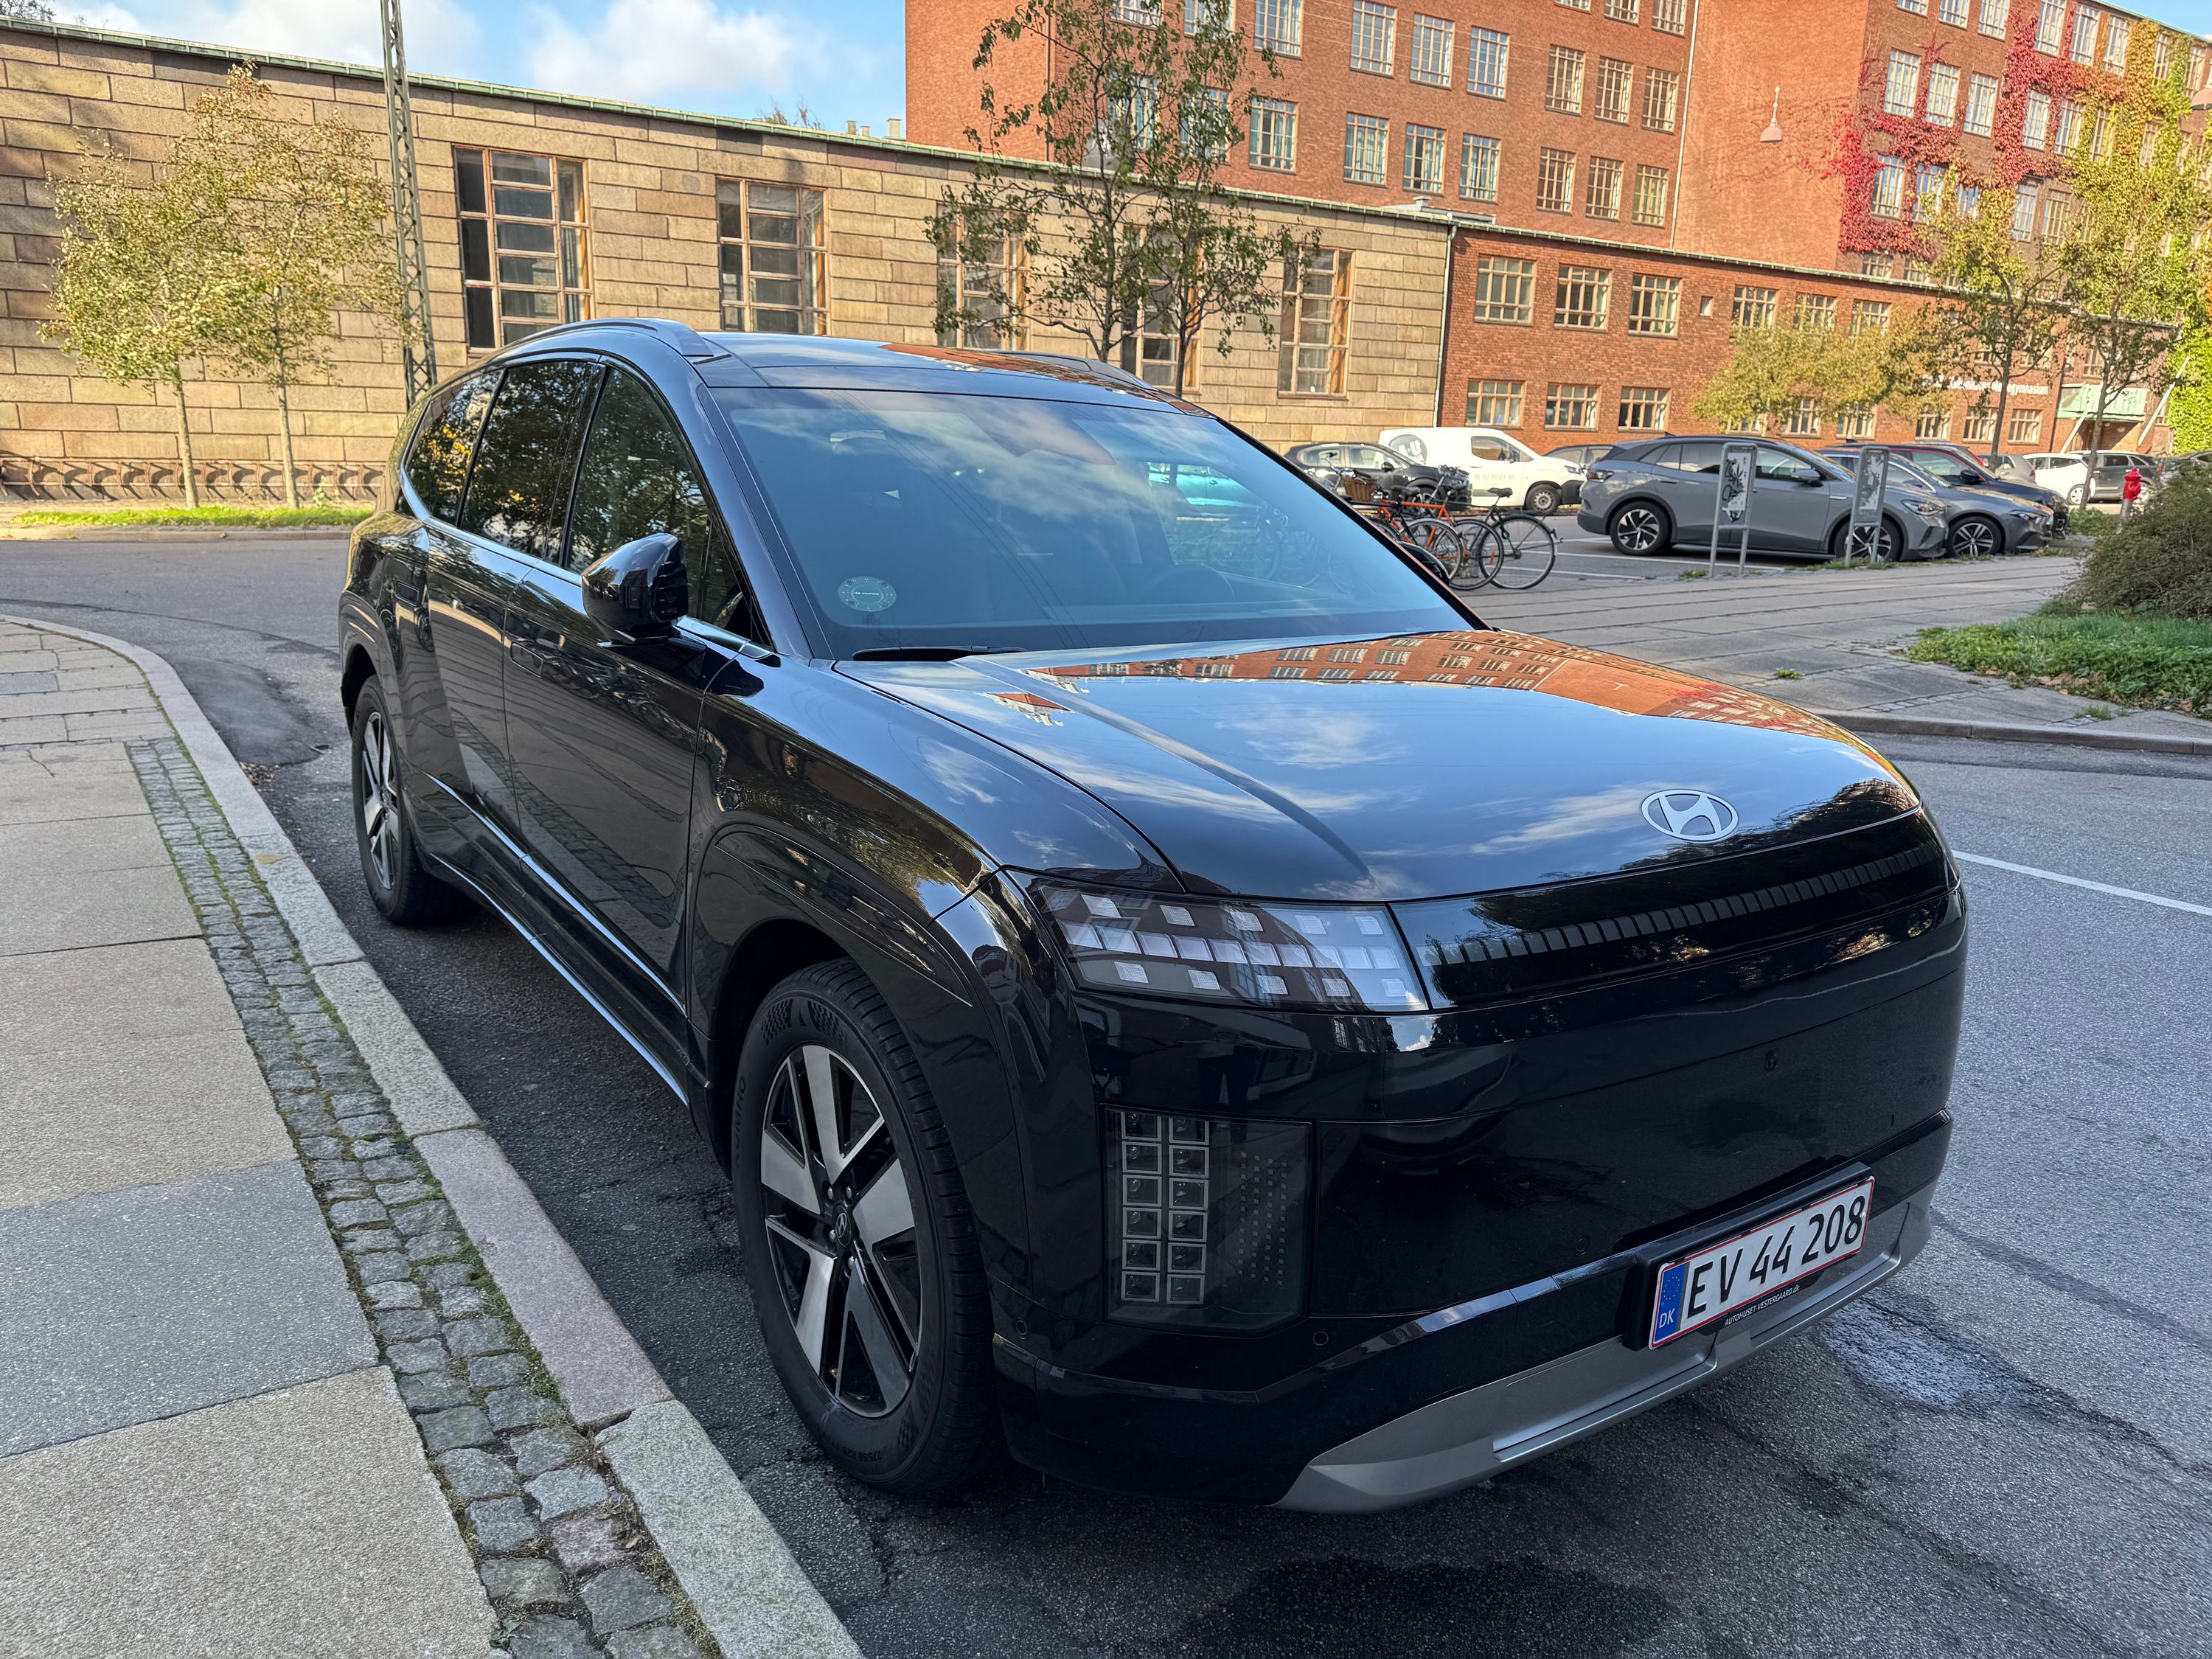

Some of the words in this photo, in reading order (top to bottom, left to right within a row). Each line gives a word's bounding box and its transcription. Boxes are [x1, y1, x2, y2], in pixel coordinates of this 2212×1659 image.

[1687, 1248, 1743, 1318] EV
[1749, 1225, 1795, 1284] 44
[1801, 1195, 1866, 1265] 208
[1659, 1308, 1675, 1329] DK
[1724, 1284, 1800, 1327] AUTOHUSET-VESTERGAARD.dk
